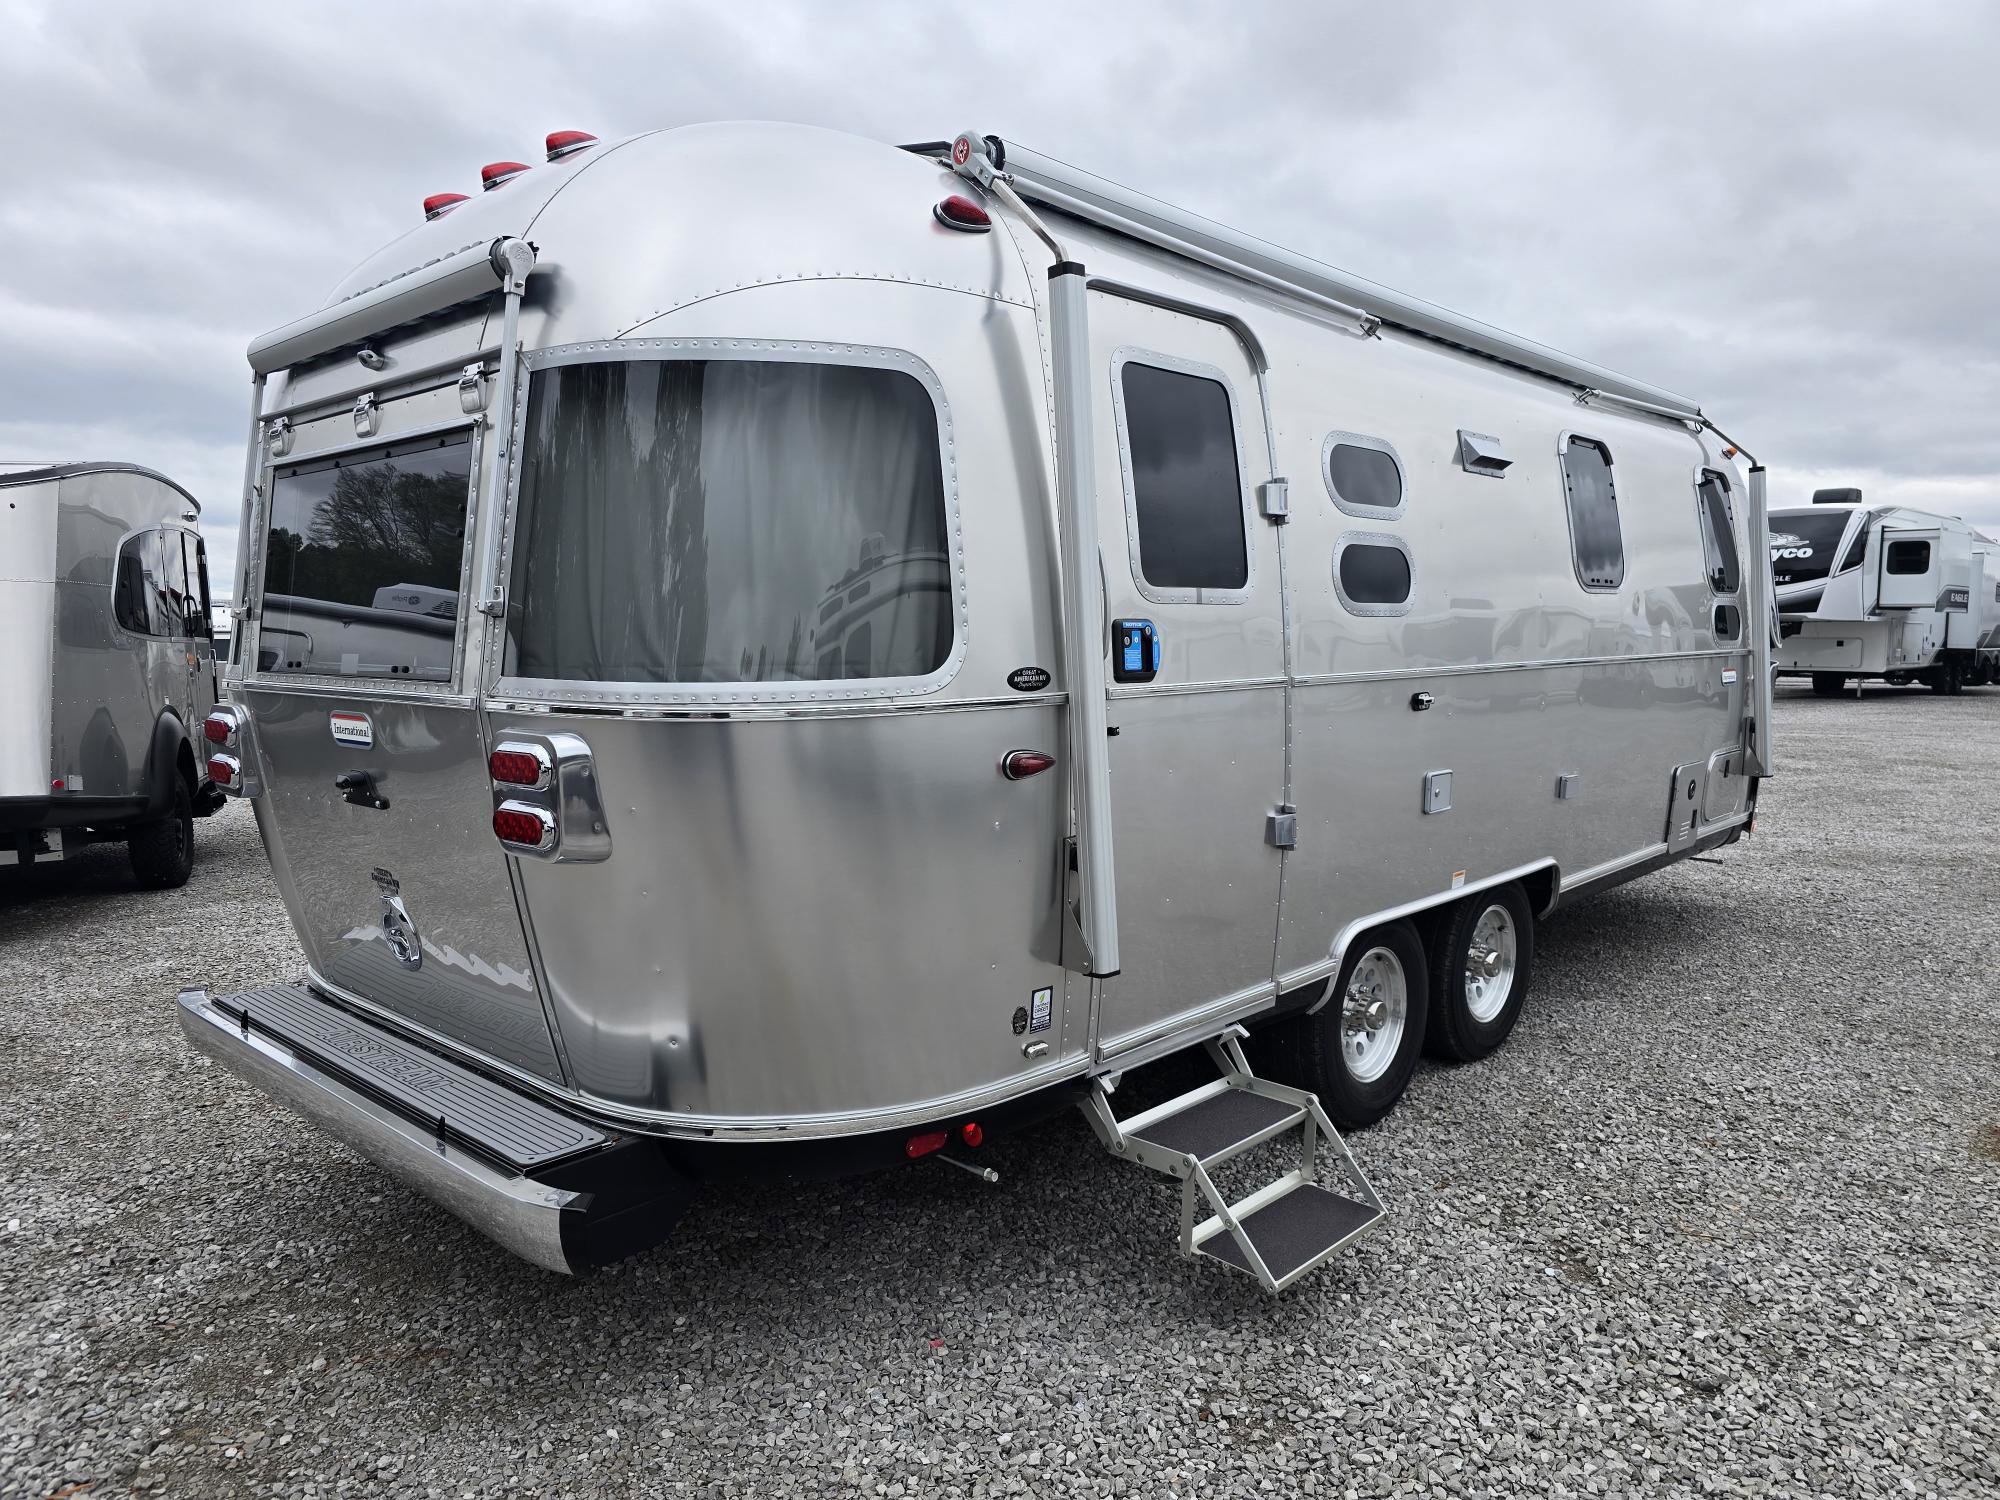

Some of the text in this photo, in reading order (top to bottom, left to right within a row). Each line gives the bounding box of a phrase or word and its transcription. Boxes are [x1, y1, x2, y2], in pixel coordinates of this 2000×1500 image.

[1770, 547, 1813, 562] yco
[1950, 593, 1969, 603] EAGLE
[333, 722, 370, 738] International
[316, 1029, 454, 1092] AIRSTREAM
